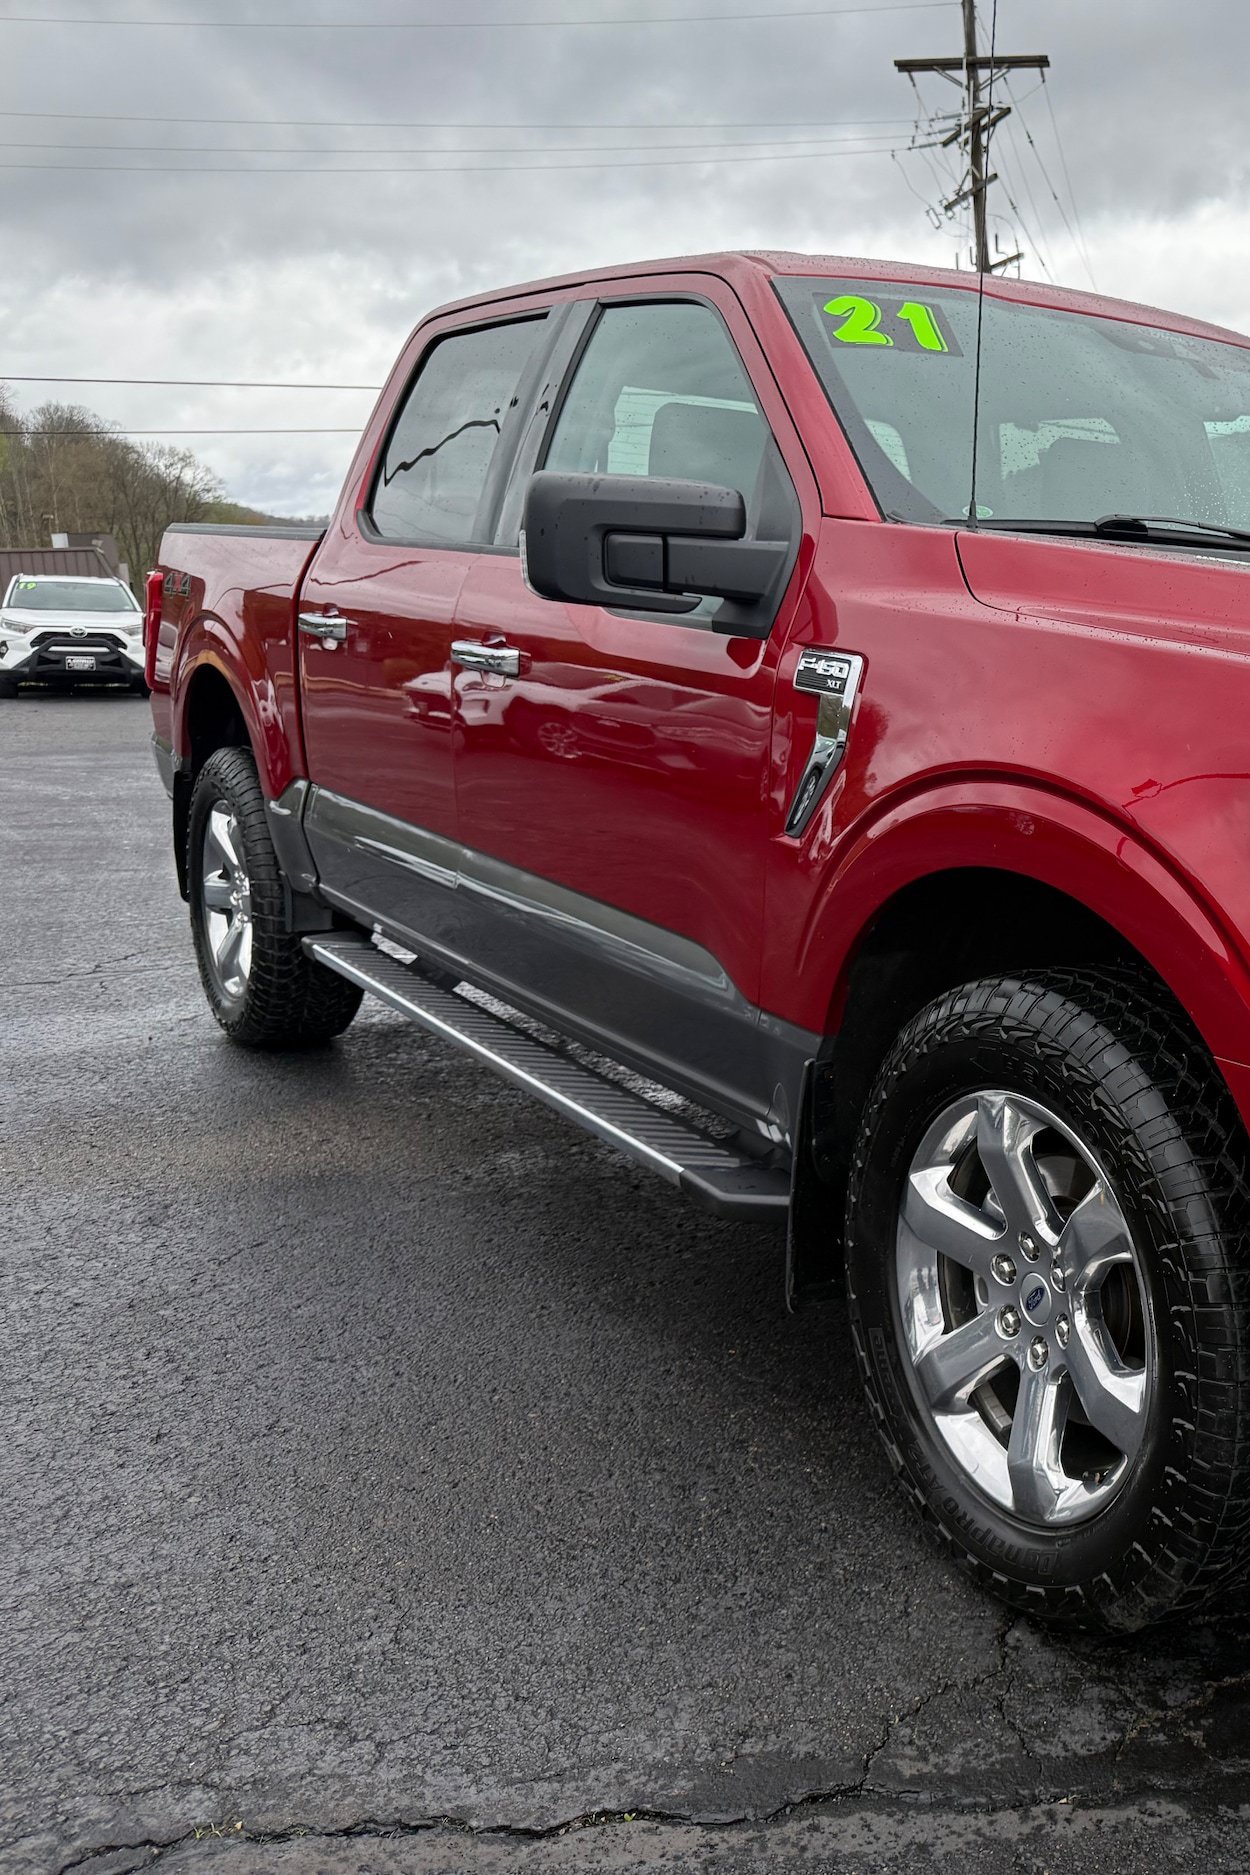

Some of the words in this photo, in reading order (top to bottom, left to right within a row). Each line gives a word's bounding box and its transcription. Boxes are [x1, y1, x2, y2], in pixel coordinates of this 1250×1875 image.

[823, 295, 949, 352] 21
[798, 657, 850, 679] F-150
[826, 679, 842, 689] XLT
